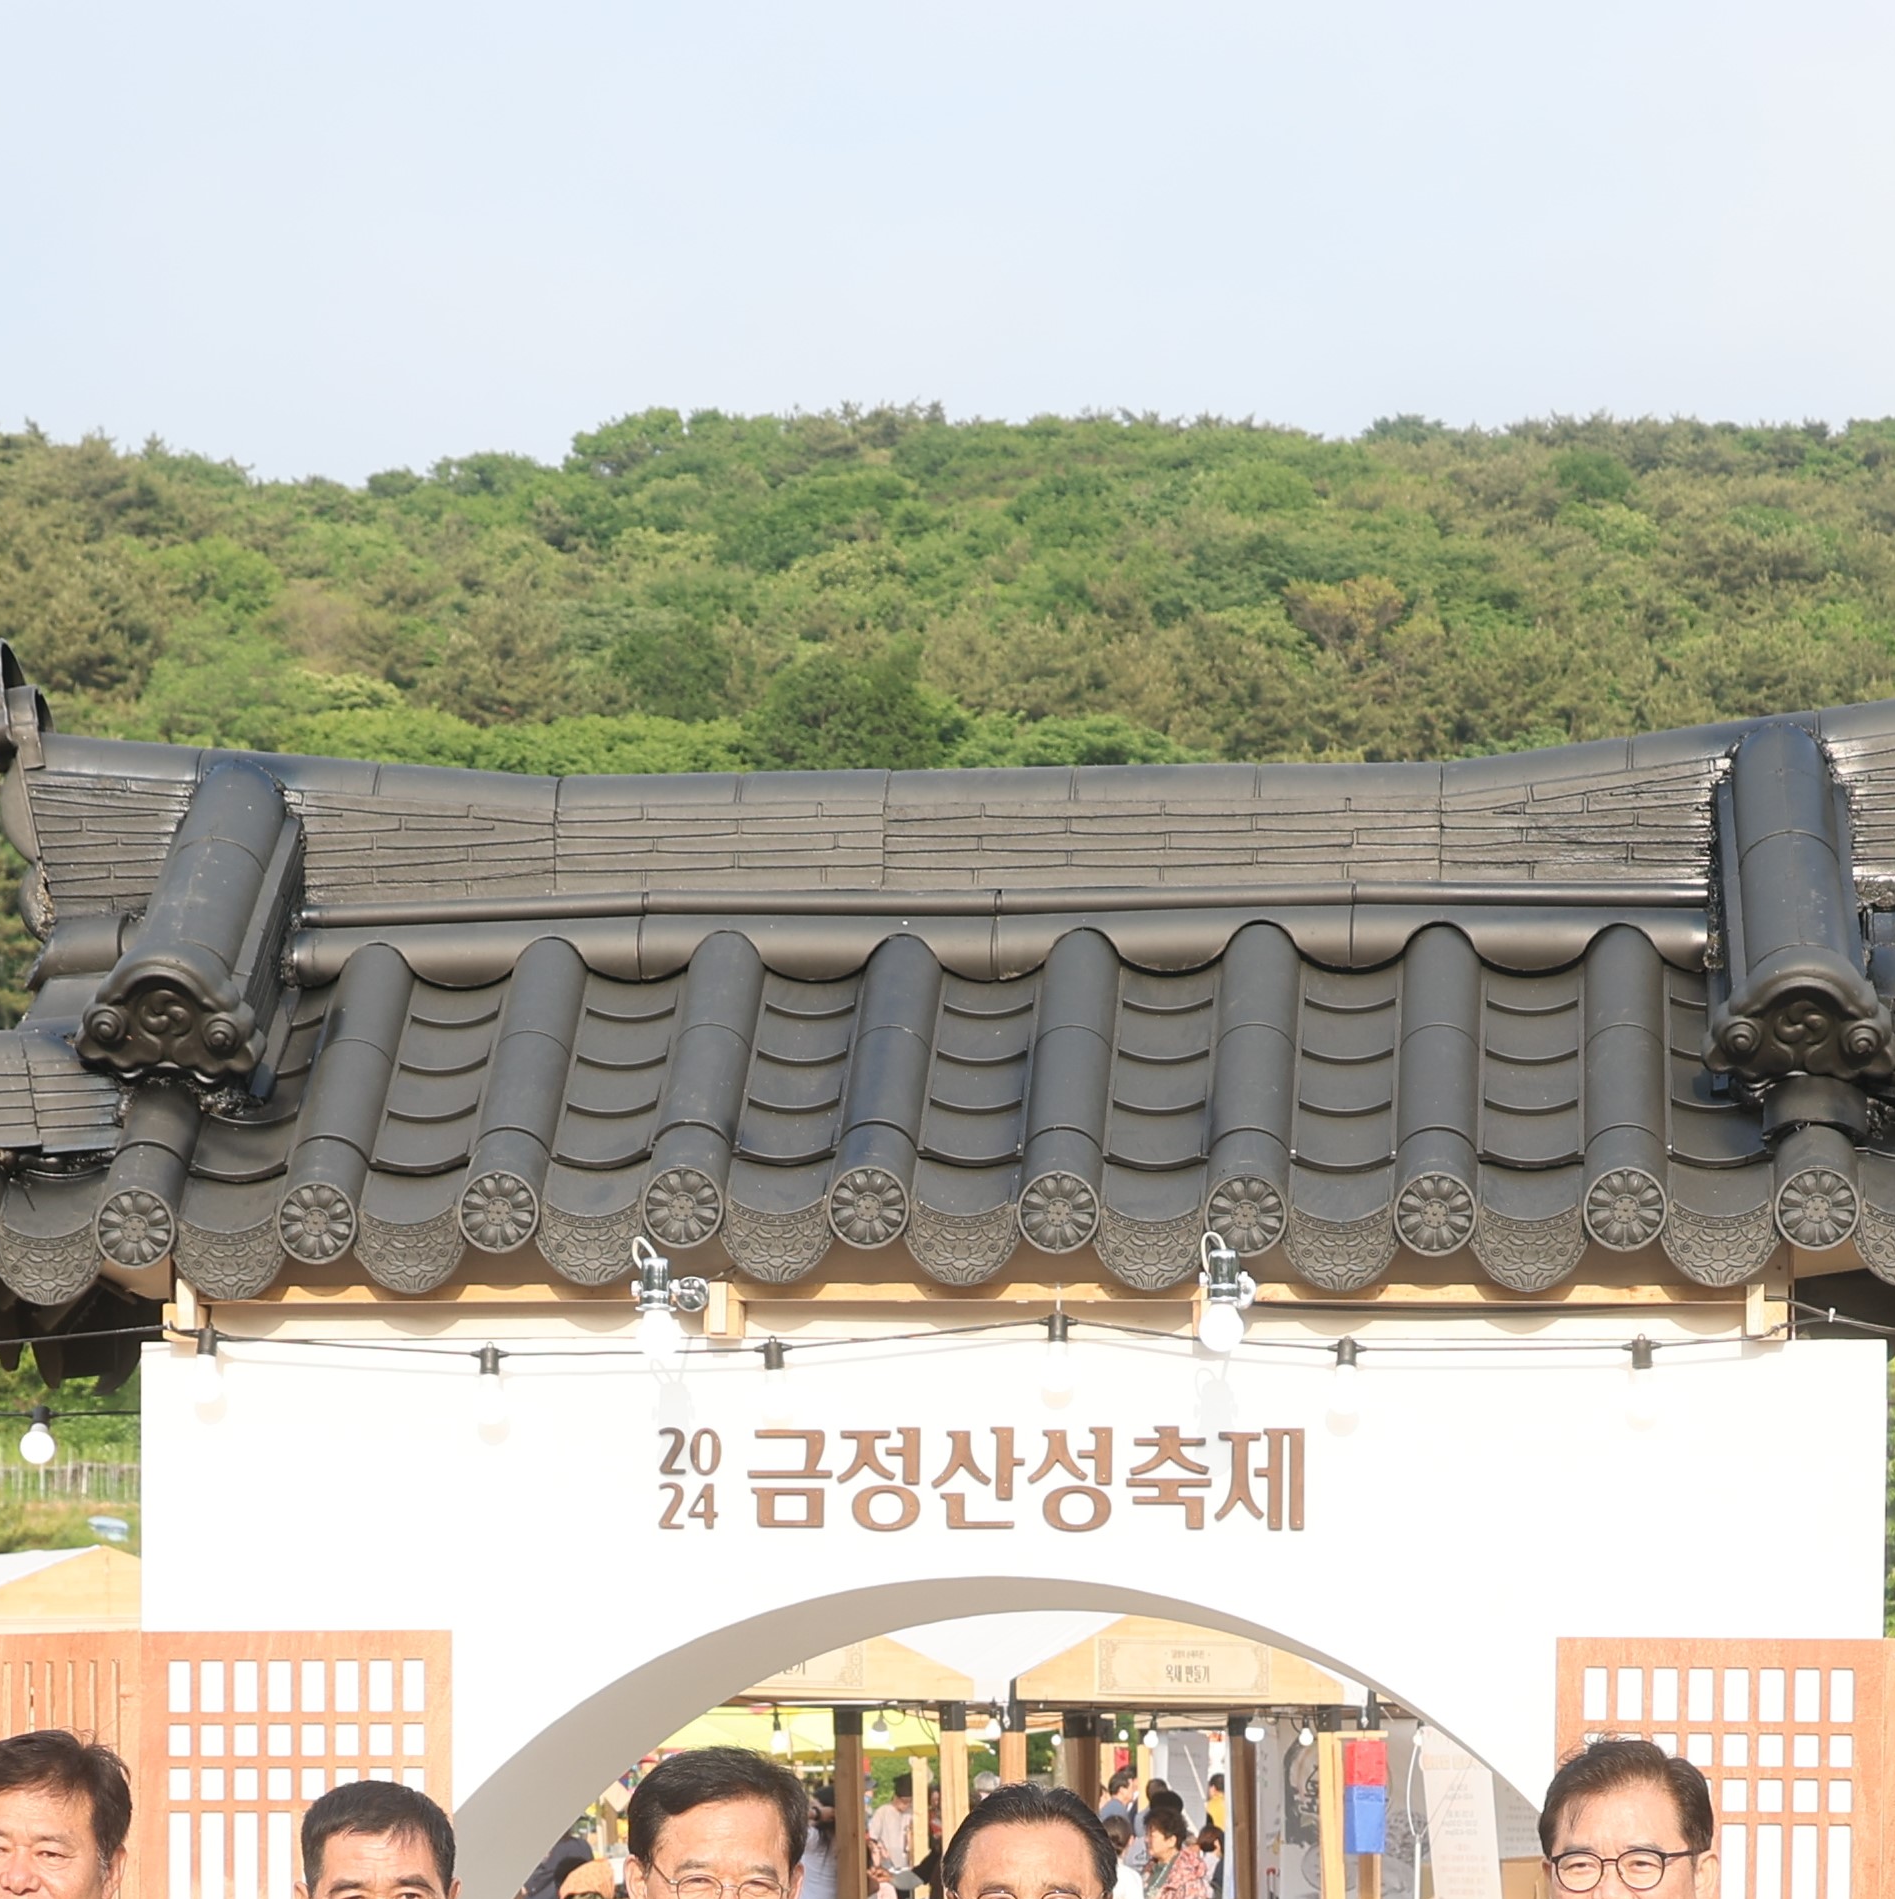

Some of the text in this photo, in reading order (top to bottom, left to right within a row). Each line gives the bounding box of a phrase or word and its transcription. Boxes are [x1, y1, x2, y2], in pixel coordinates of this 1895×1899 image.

[658, 1426, 722, 1476] 20
[747, 1425, 1306, 1533] 금정산성축제
[658, 1482, 719, 1530] 24
